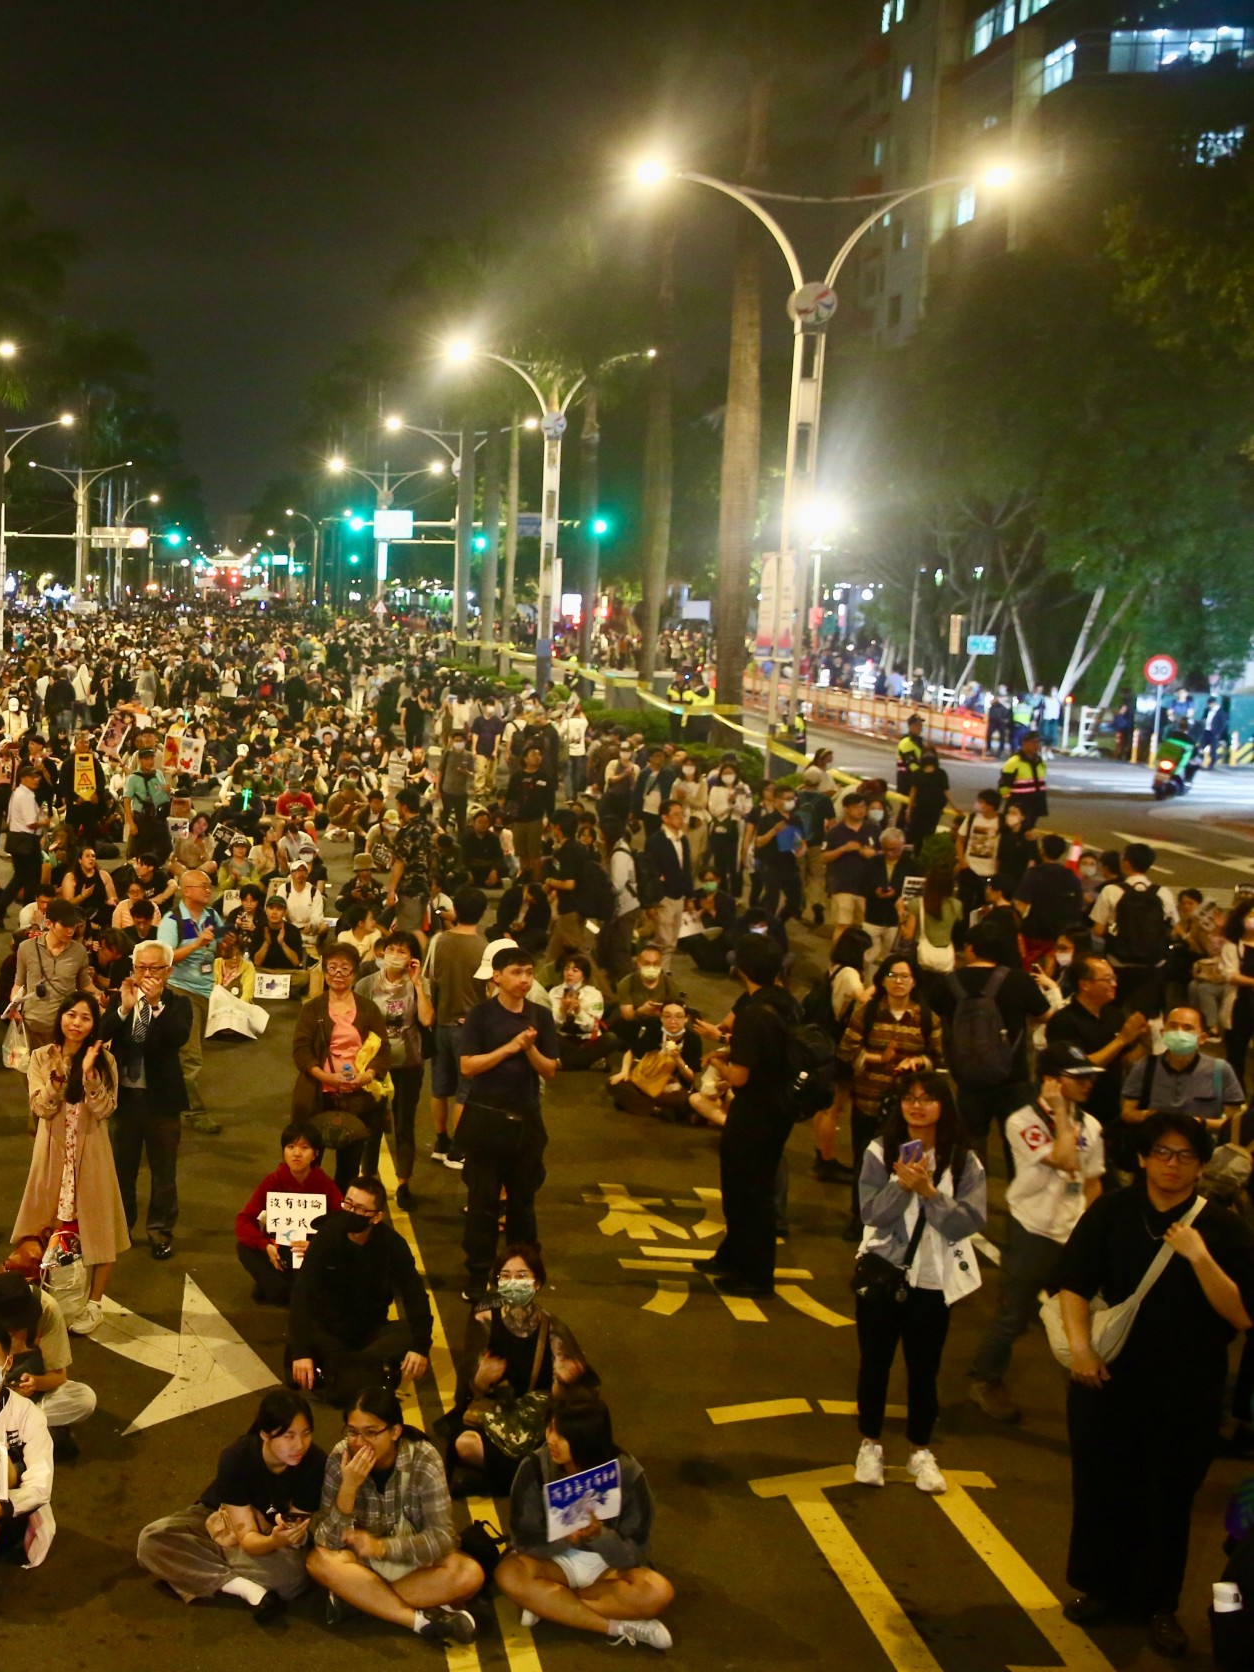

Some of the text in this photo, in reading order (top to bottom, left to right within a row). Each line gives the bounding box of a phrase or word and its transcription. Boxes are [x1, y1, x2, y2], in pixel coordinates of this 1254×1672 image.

[270, 1197, 323, 1210] 沒有討論
[271, 1217, 309, 1230] 不是民
